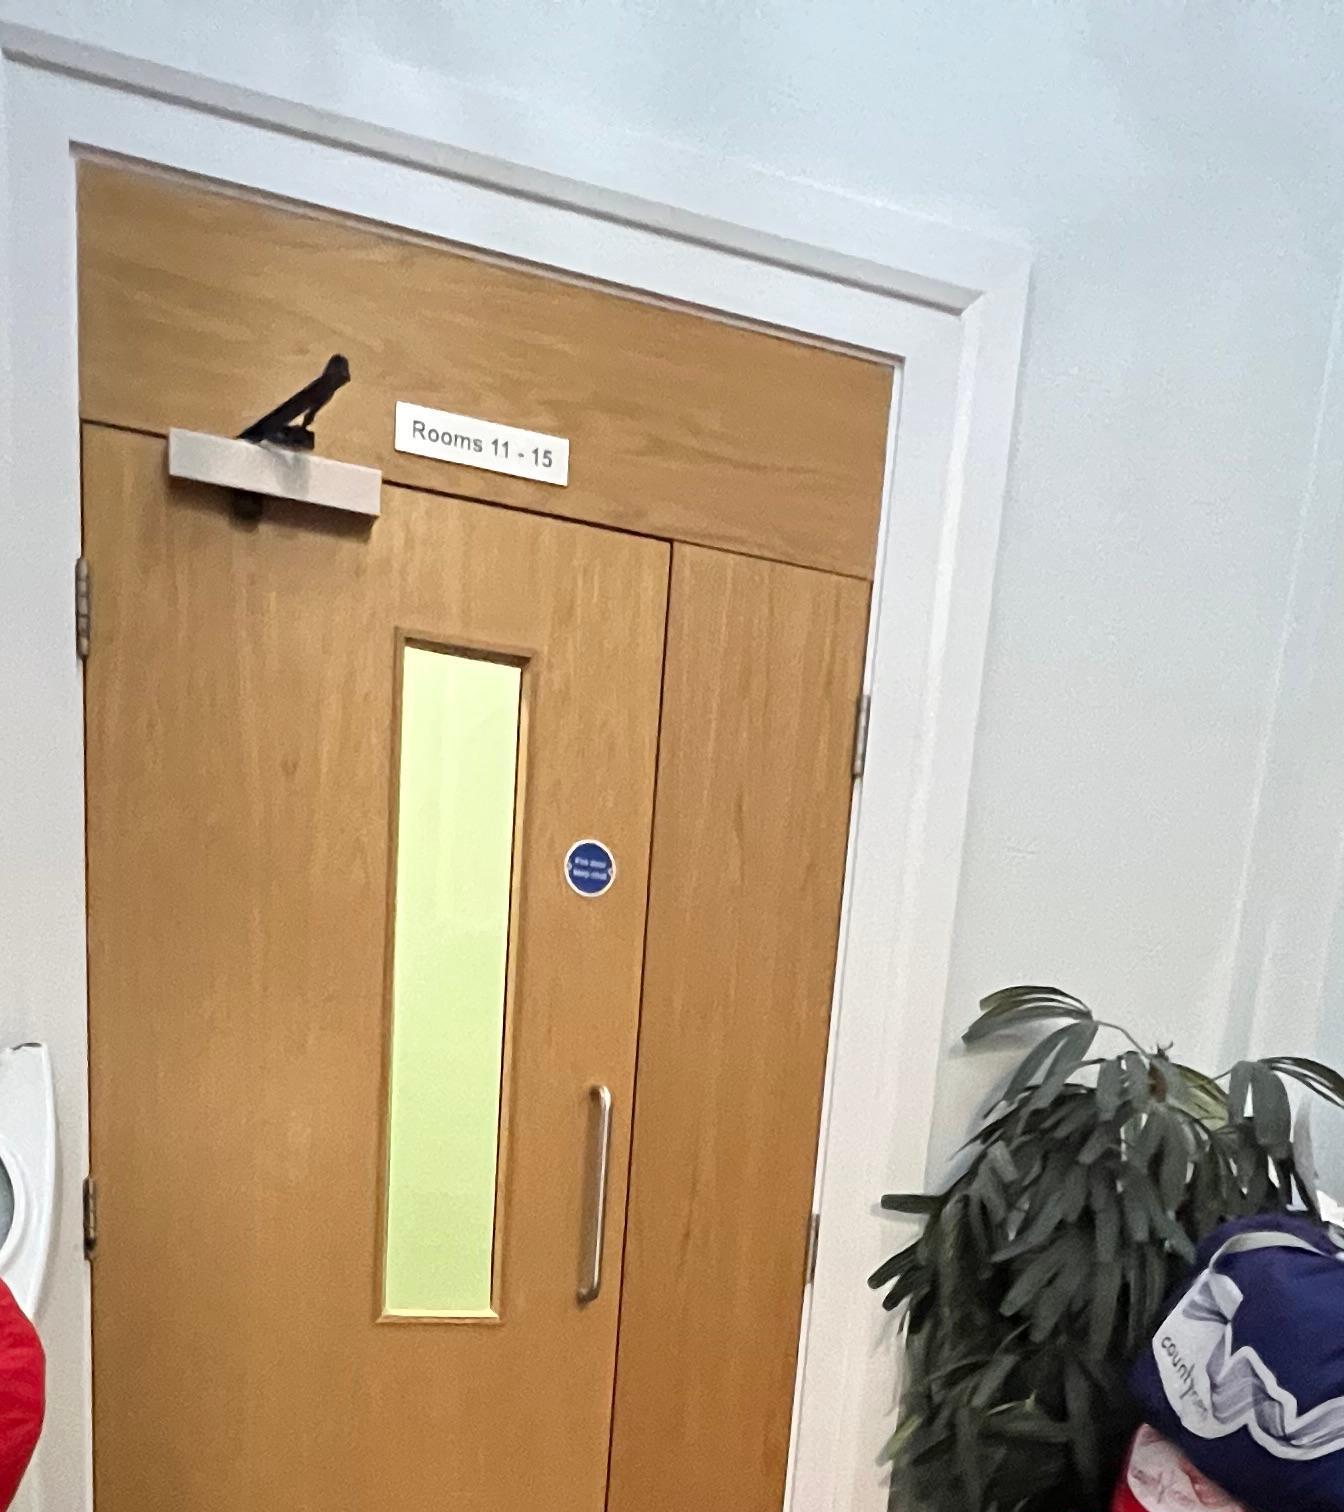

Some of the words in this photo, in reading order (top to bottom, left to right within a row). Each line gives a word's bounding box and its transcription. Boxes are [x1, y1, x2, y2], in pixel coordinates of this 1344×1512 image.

[412, 420, 483, 452] Rooms
[491, 439, 509, 458] 11
[532, 449, 553, 468] 15
